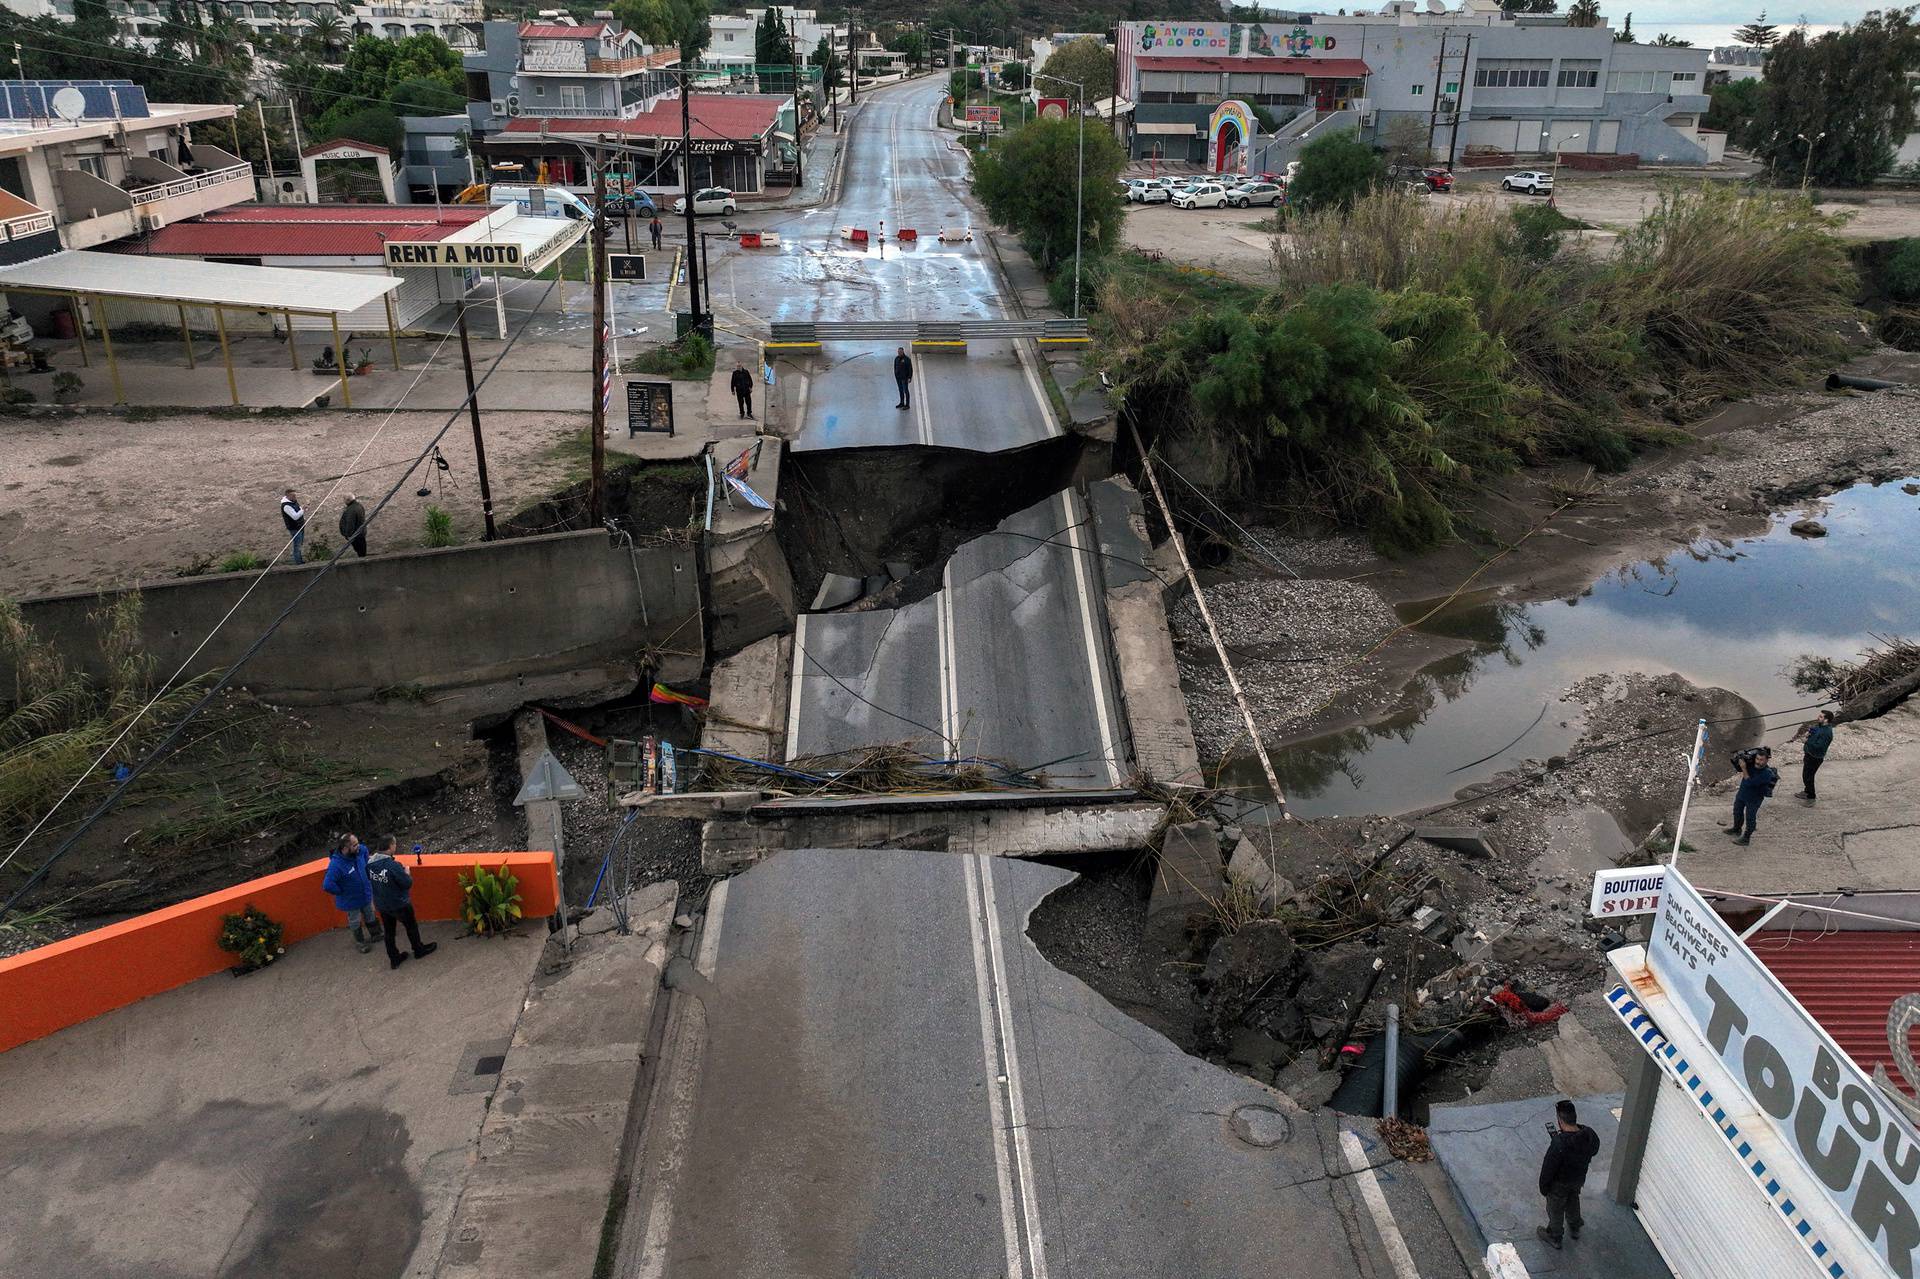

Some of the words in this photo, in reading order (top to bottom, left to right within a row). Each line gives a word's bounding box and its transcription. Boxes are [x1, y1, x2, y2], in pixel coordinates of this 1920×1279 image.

[389, 245, 438, 264] RENT
[445, 246, 460, 263] A
[465, 246, 519, 263] MOTO
[1604, 877, 1664, 895] BOUTIQUE
[1665, 909, 1716, 966] BEACHWEAR
[1667, 893, 1682, 915] SUN
[1684, 907, 1729, 959] GLASSES
[1664, 928, 1698, 970] HATS
